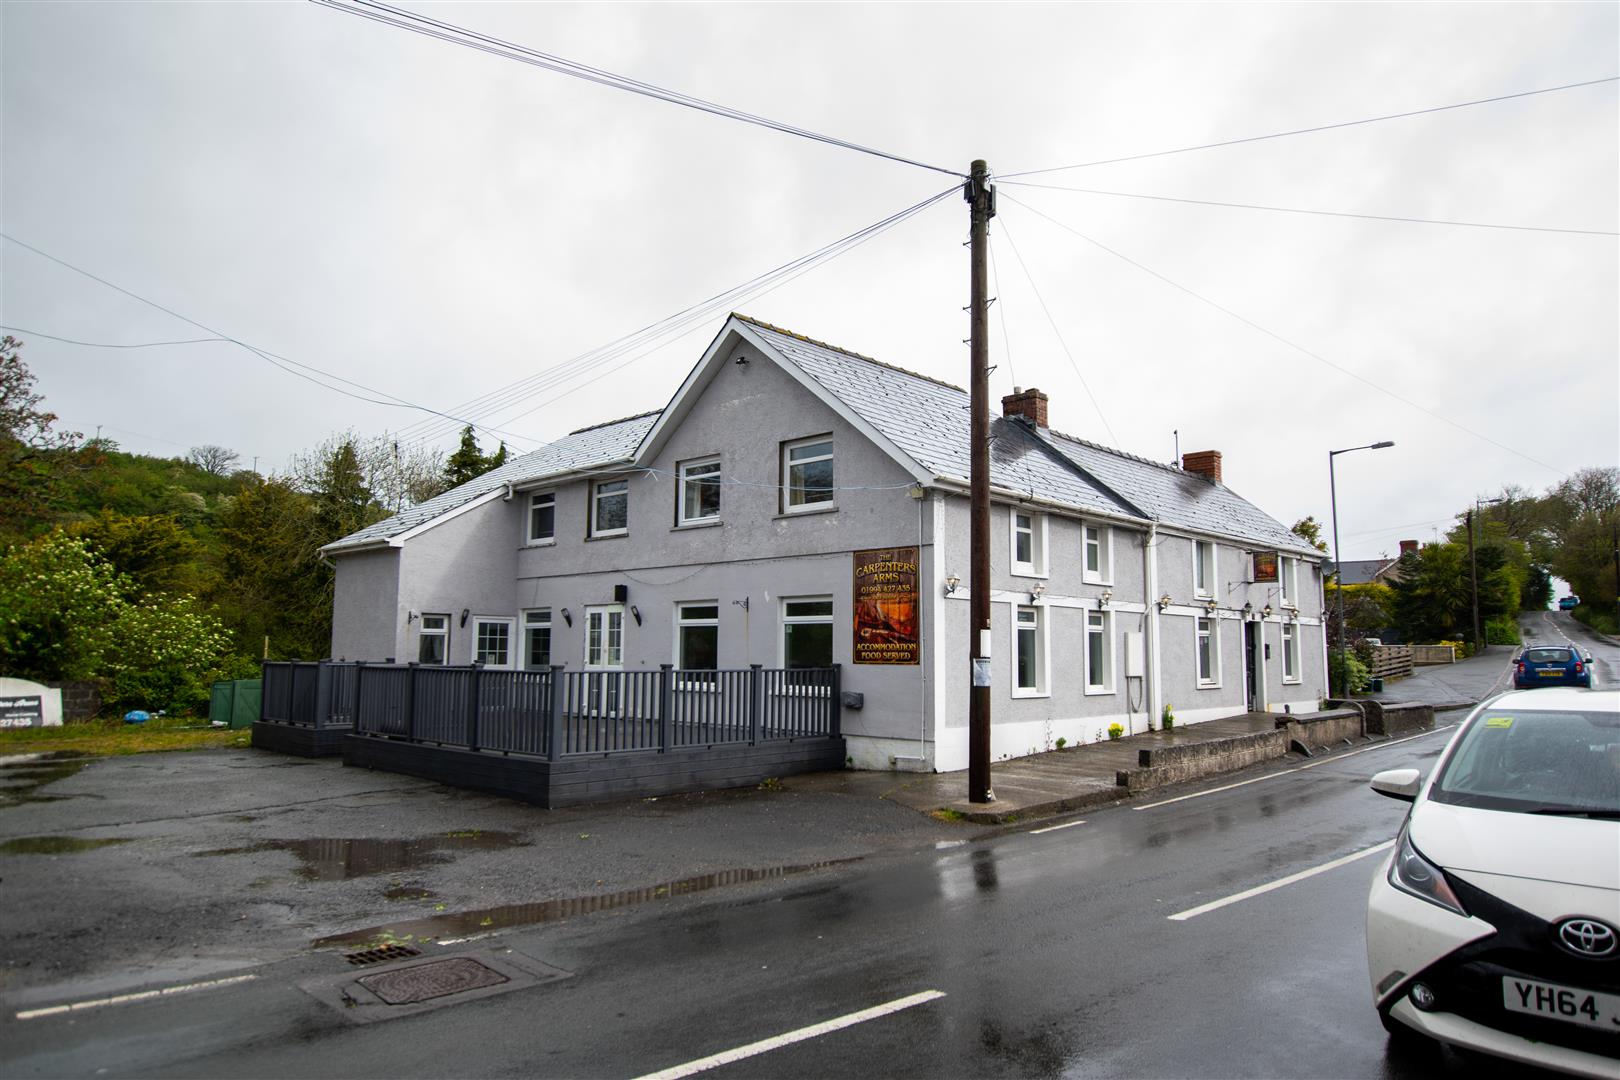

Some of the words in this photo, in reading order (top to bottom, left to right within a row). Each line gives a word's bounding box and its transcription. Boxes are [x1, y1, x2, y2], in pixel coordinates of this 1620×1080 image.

[856, 562, 916, 576] CARPENTERS
[873, 572, 900, 582] ARMS
[882, 652, 911, 660] SERVED
[1515, 982, 1600, 1021] YH64
